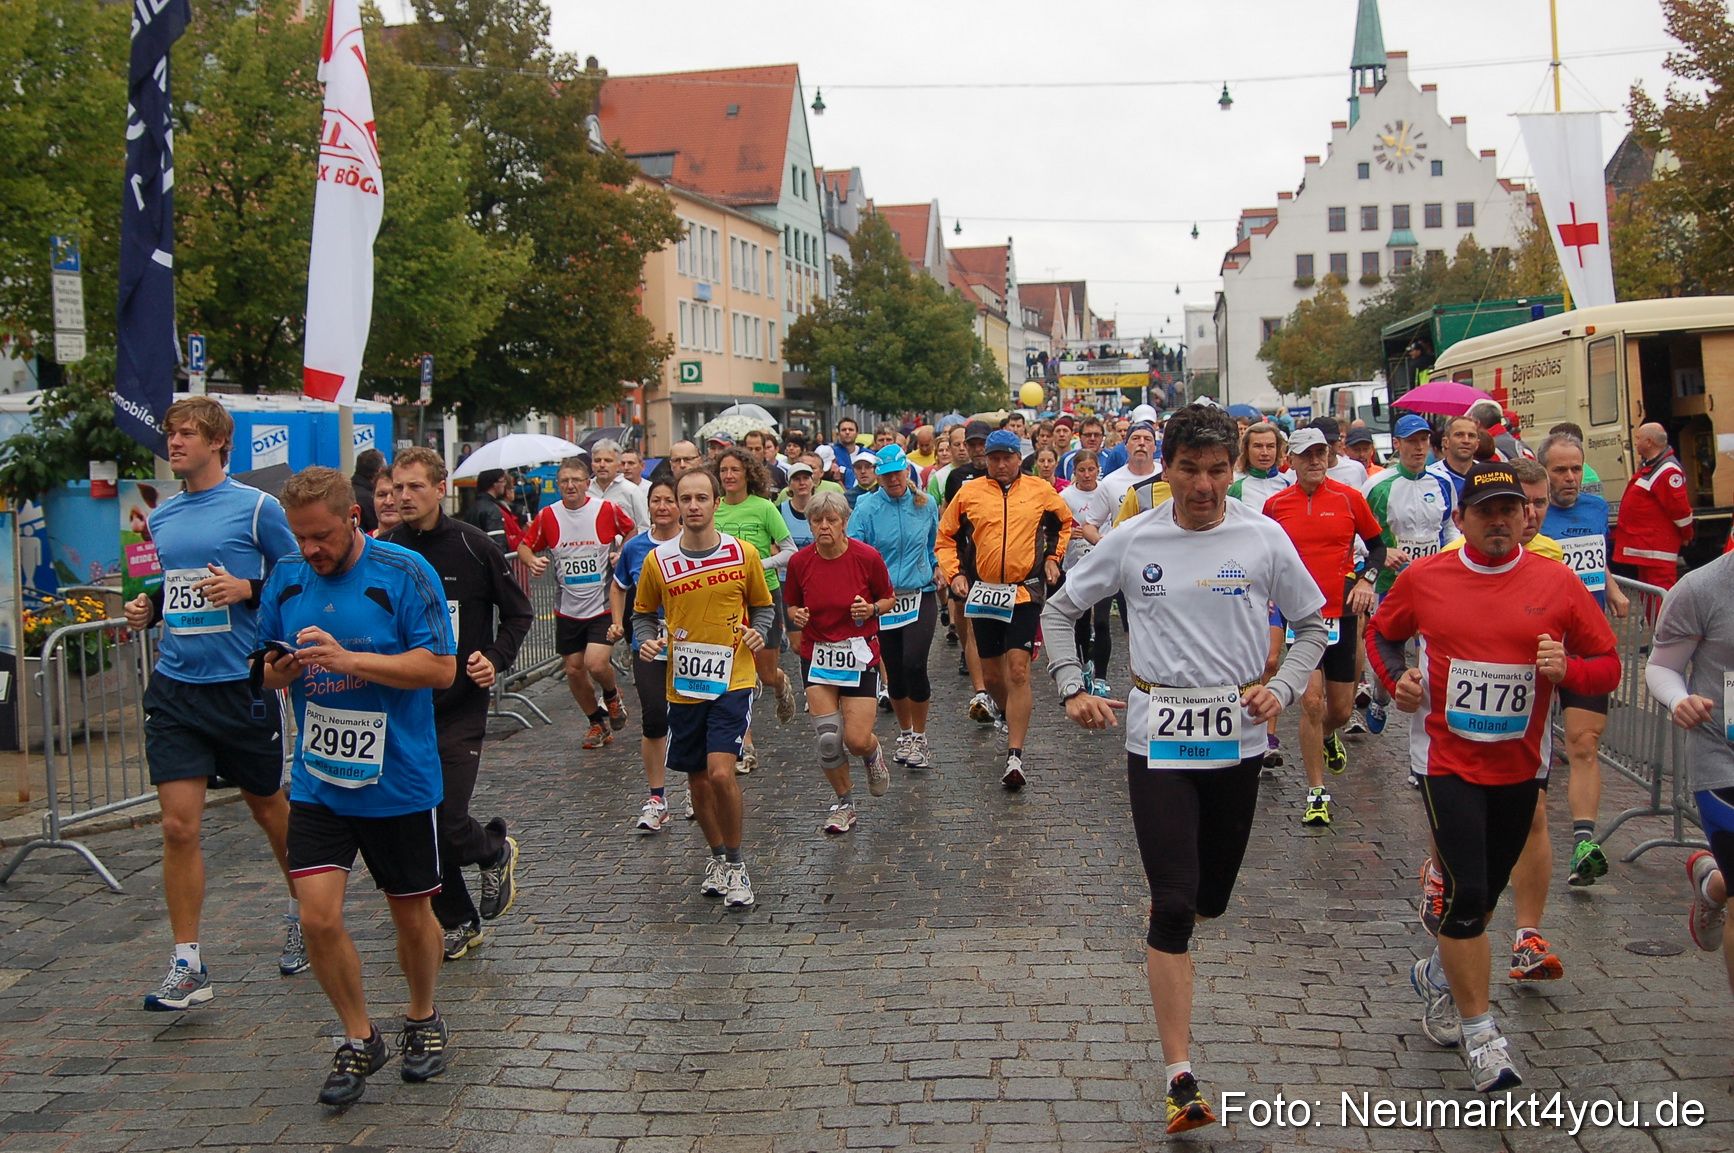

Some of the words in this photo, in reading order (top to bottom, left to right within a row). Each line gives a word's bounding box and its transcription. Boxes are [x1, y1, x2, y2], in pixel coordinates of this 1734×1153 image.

[192, 339, 202, 367] P
[683, 364, 699, 381] D
[1512, 357, 1562, 385] Bayerisches
[1088, 378, 1119, 386] START
[1512, 387, 1536, 406] Rotes
[1520, 413, 1535, 430] euz
[252, 429, 288, 453] DIXI
[353, 428, 374, 445] IXI
[1588, 435, 1618, 451] Bayerisches
[1402, 544, 1438, 561] 2810
[1562, 548, 1605, 572] 2233
[564, 559, 602, 575] 2698
[668, 578, 704, 598] MAX
[707, 570, 747, 587] BÖGL
[1141, 584, 1166, 592] PARTL
[169, 586, 206, 610] 253
[888, 596, 917, 614] 601
[971, 589, 1011, 609] 2602
[181, 615, 205, 625] Peter
[674, 645, 694, 654] PARTL
[694, 648, 723, 657] Neumarkt
[816, 648, 856, 669] 3190
[678, 654, 726, 680] 3044
[1452, 666, 1479, 678] PARTL
[1481, 671, 1522, 681] Neumarkt
[688, 681, 711, 692] Stefan
[1152, 695, 1181, 705] PARTL
[1182, 695, 1225, 704] Neumarkt
[1455, 680, 1527, 713] 2178
[307, 709, 328, 723] PARTL
[328, 716, 370, 727] Neumarkt
[1157, 706, 1233, 737] 2416
[310, 723, 377, 760] 2992
[1179, 744, 1211, 757] Peter
[314, 759, 366, 778] Alexander
